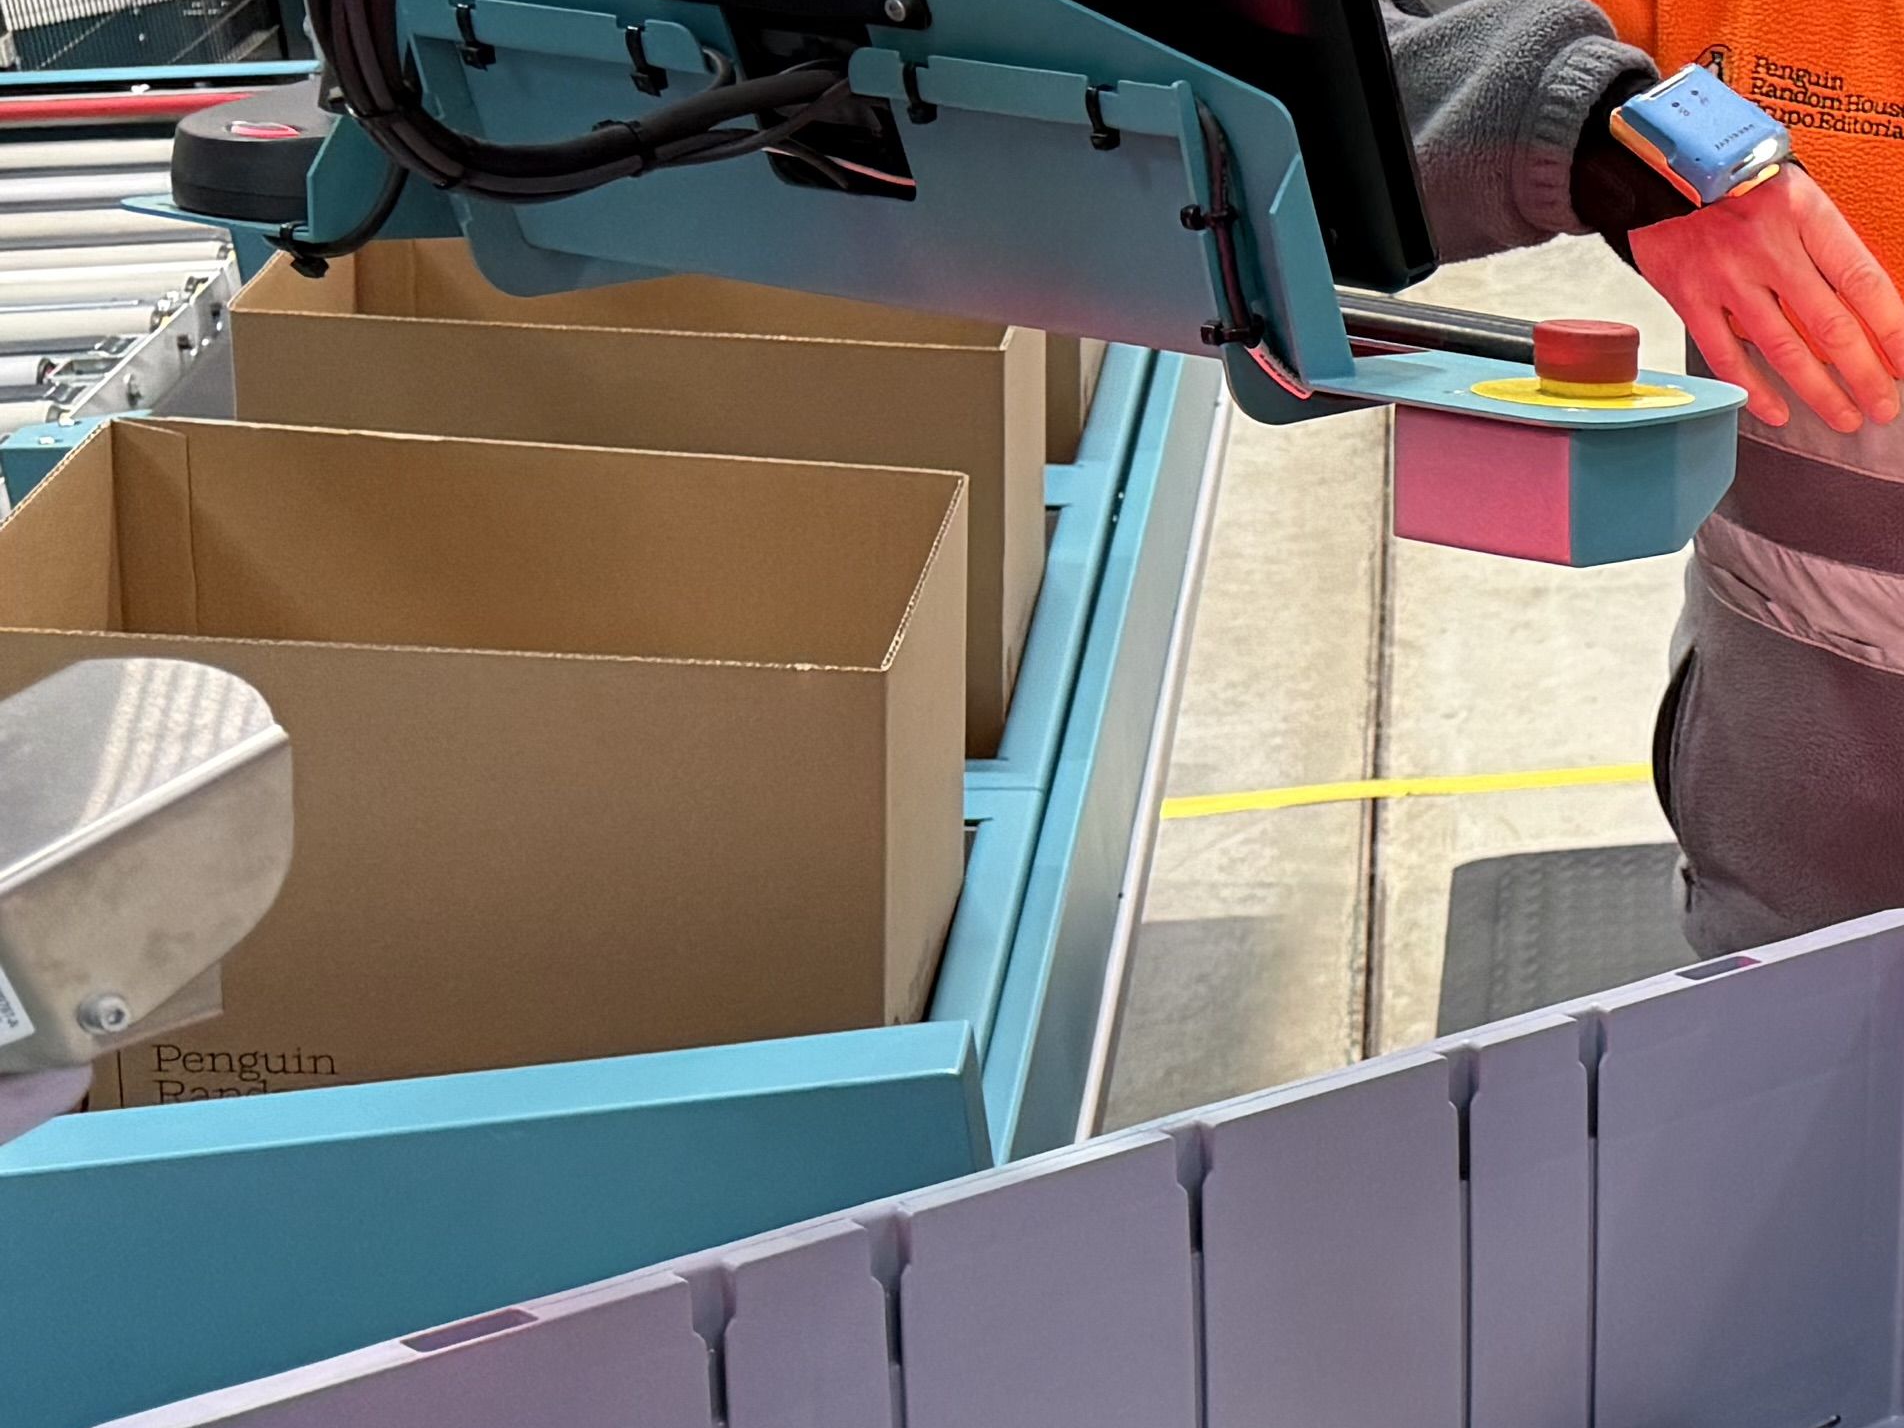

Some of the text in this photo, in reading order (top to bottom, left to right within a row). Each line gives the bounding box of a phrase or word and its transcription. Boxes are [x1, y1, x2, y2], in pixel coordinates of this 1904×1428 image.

[1753, 55, 1843, 91] Penguin
[1751, 77, 1843, 111] Random
[152, 1044, 338, 1082] Penguin
[152, 1079, 287, 1105] Rand
